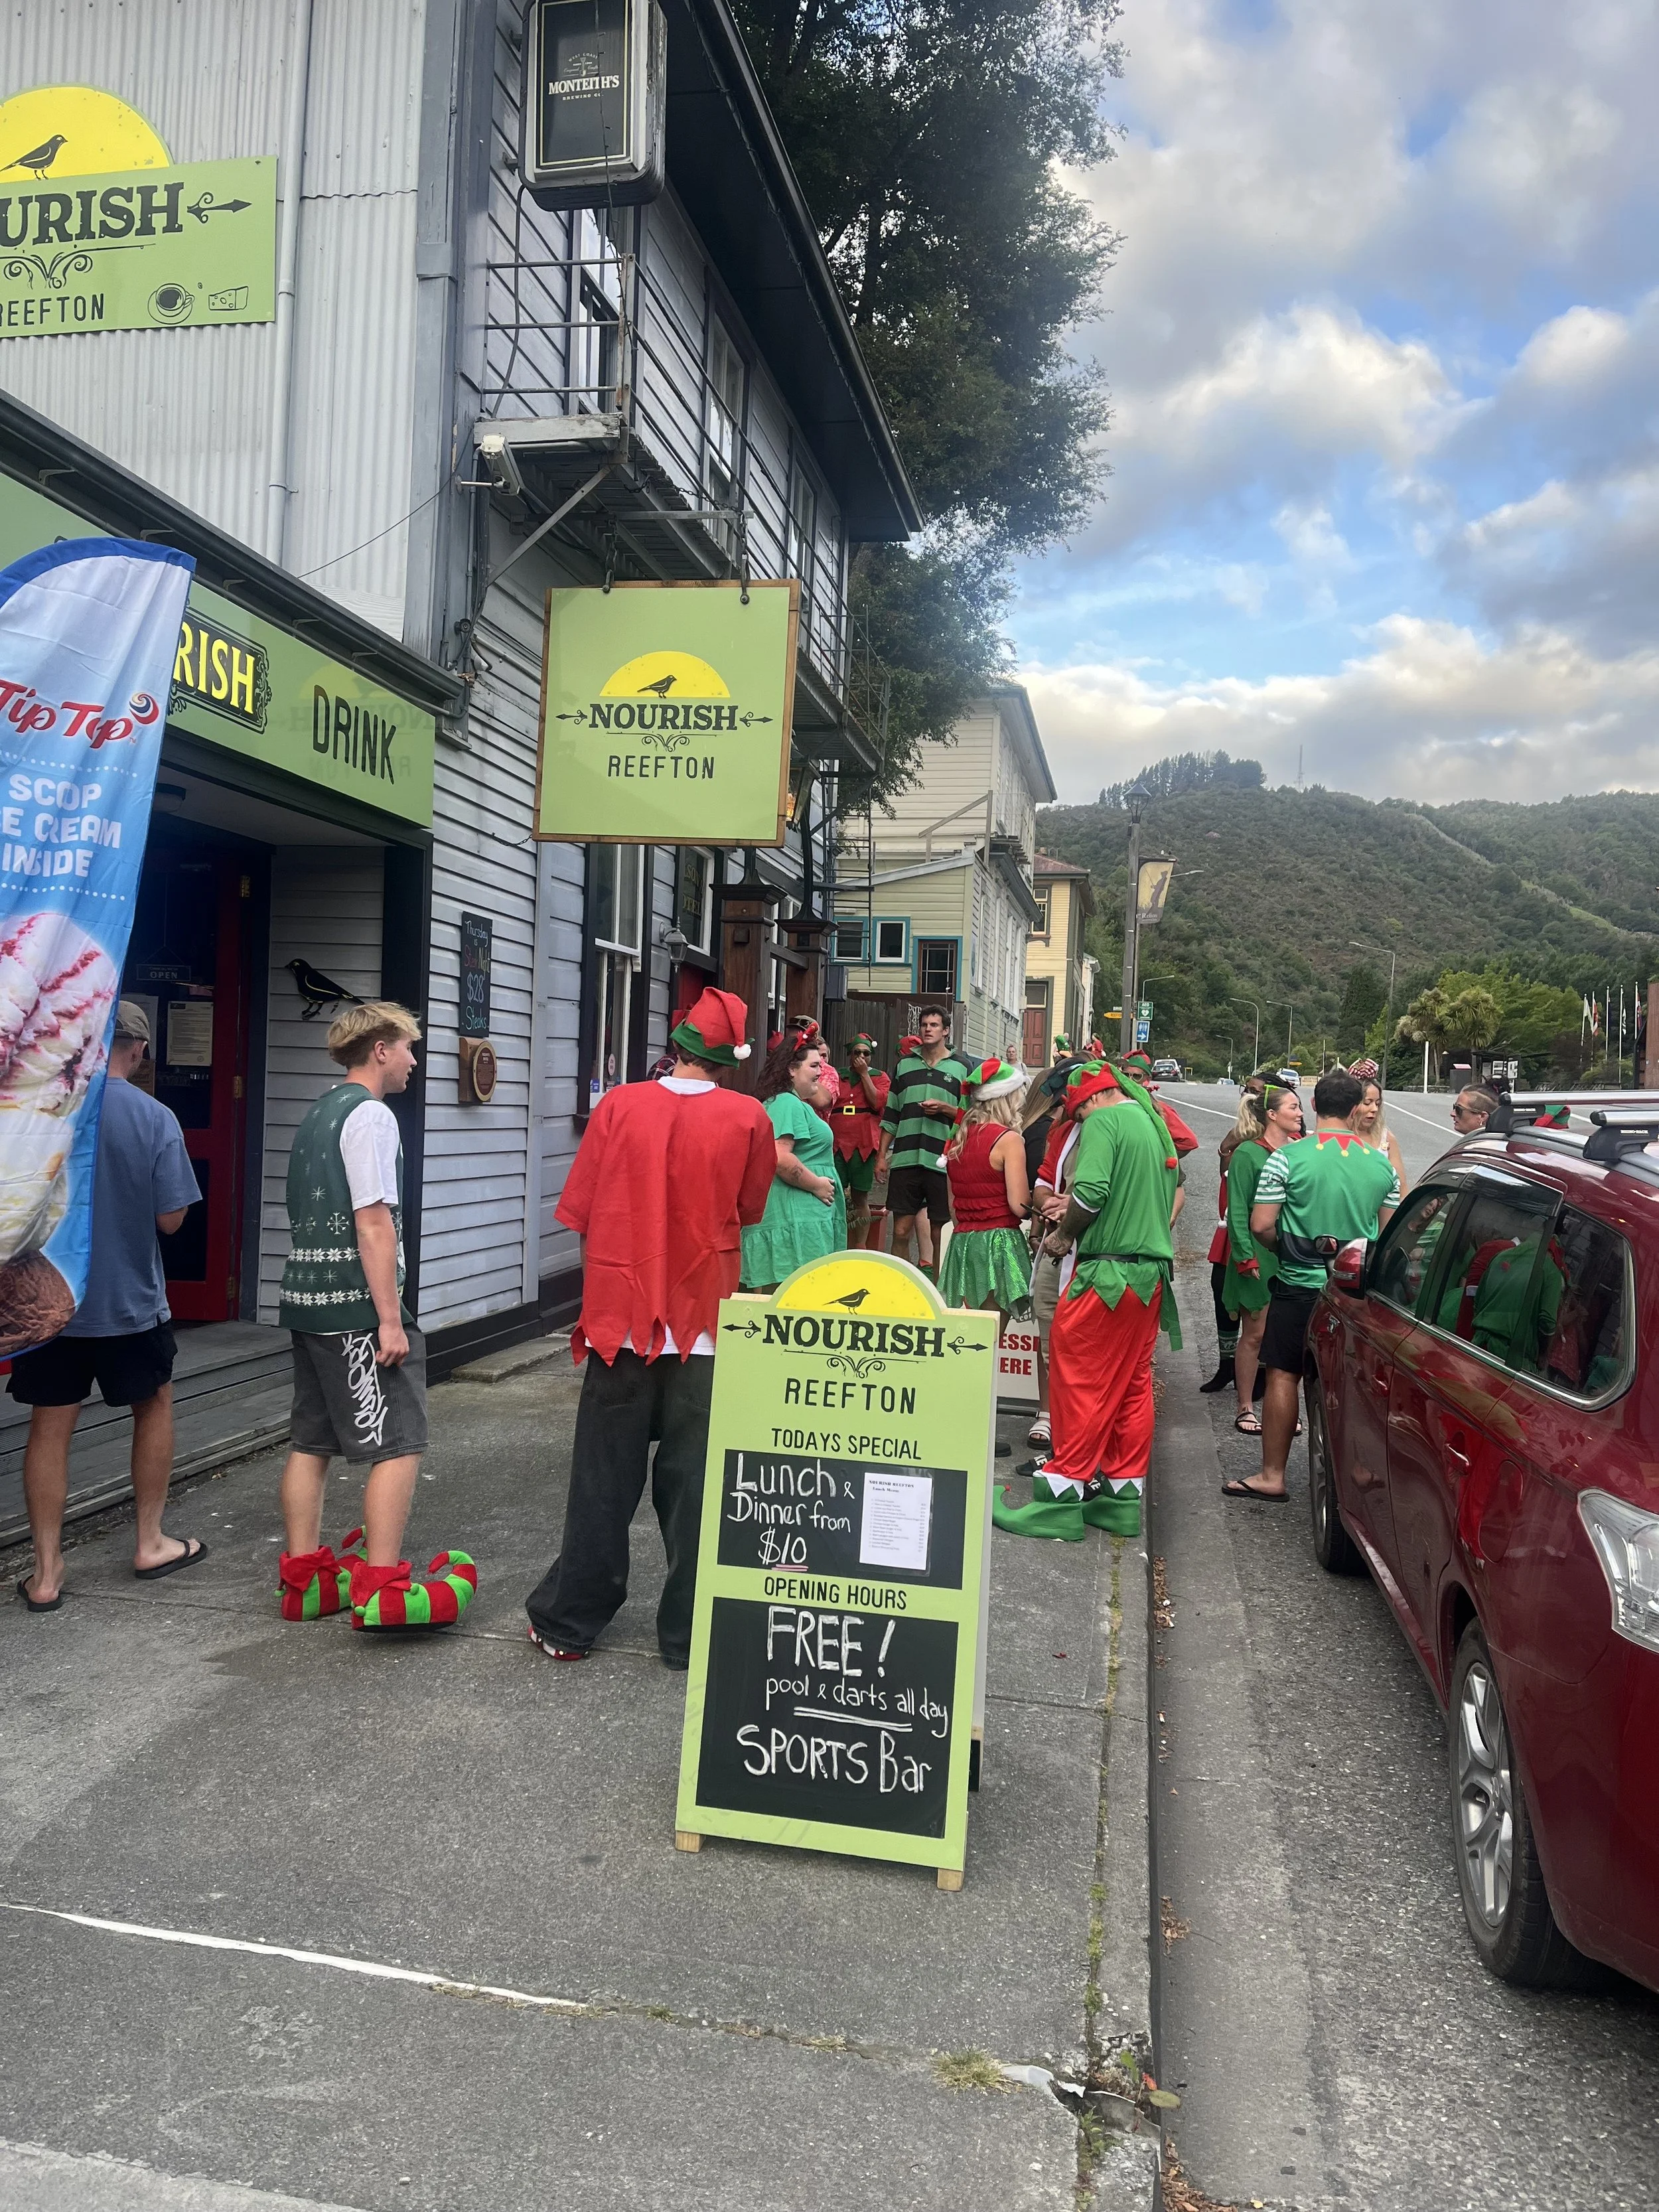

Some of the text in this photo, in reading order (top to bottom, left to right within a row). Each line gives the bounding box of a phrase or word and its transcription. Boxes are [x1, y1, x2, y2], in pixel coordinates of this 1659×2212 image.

[548, 75, 620, 95] MONTEITH'S
[0, 182, 184, 248] URISH
[0, 293, 104, 327] EEFTON
[173, 621, 255, 714] RISH
[0, 679, 56, 733] Tip
[589, 703, 739, 731] NOURISH
[313, 684, 396, 785] DRINK
[608, 755, 715, 780] REEFTON
[35, 812, 121, 849] CREAM
[2, 843, 93, 877] INSIDE
[466, 920, 488, 948] Thursday
[467, 972, 484, 1003] $28
[466, 1005, 487, 1030] Steaks
[762, 1315, 946, 1357] NOURISH
[997, 1357, 1032, 1375] ERE
[784, 1378, 916, 1414] REEFTON
[772, 1428, 921, 1460] TODAYS SPECIAL
[736, 1453, 855, 1499] Lunch &
[727, 1491, 807, 1526] Dinner
[808, 1500, 851, 1532] from
[758, 1526, 807, 1565] $10
[764, 1576, 906, 1610] OPENING HOURS
[766, 1675, 808, 1710] pool
[833, 1678, 887, 1710] darts
[894, 1688, 914, 1716] all
[919, 1687, 948, 1738] day
[737, 1724, 932, 1793] SPORTS Bar
